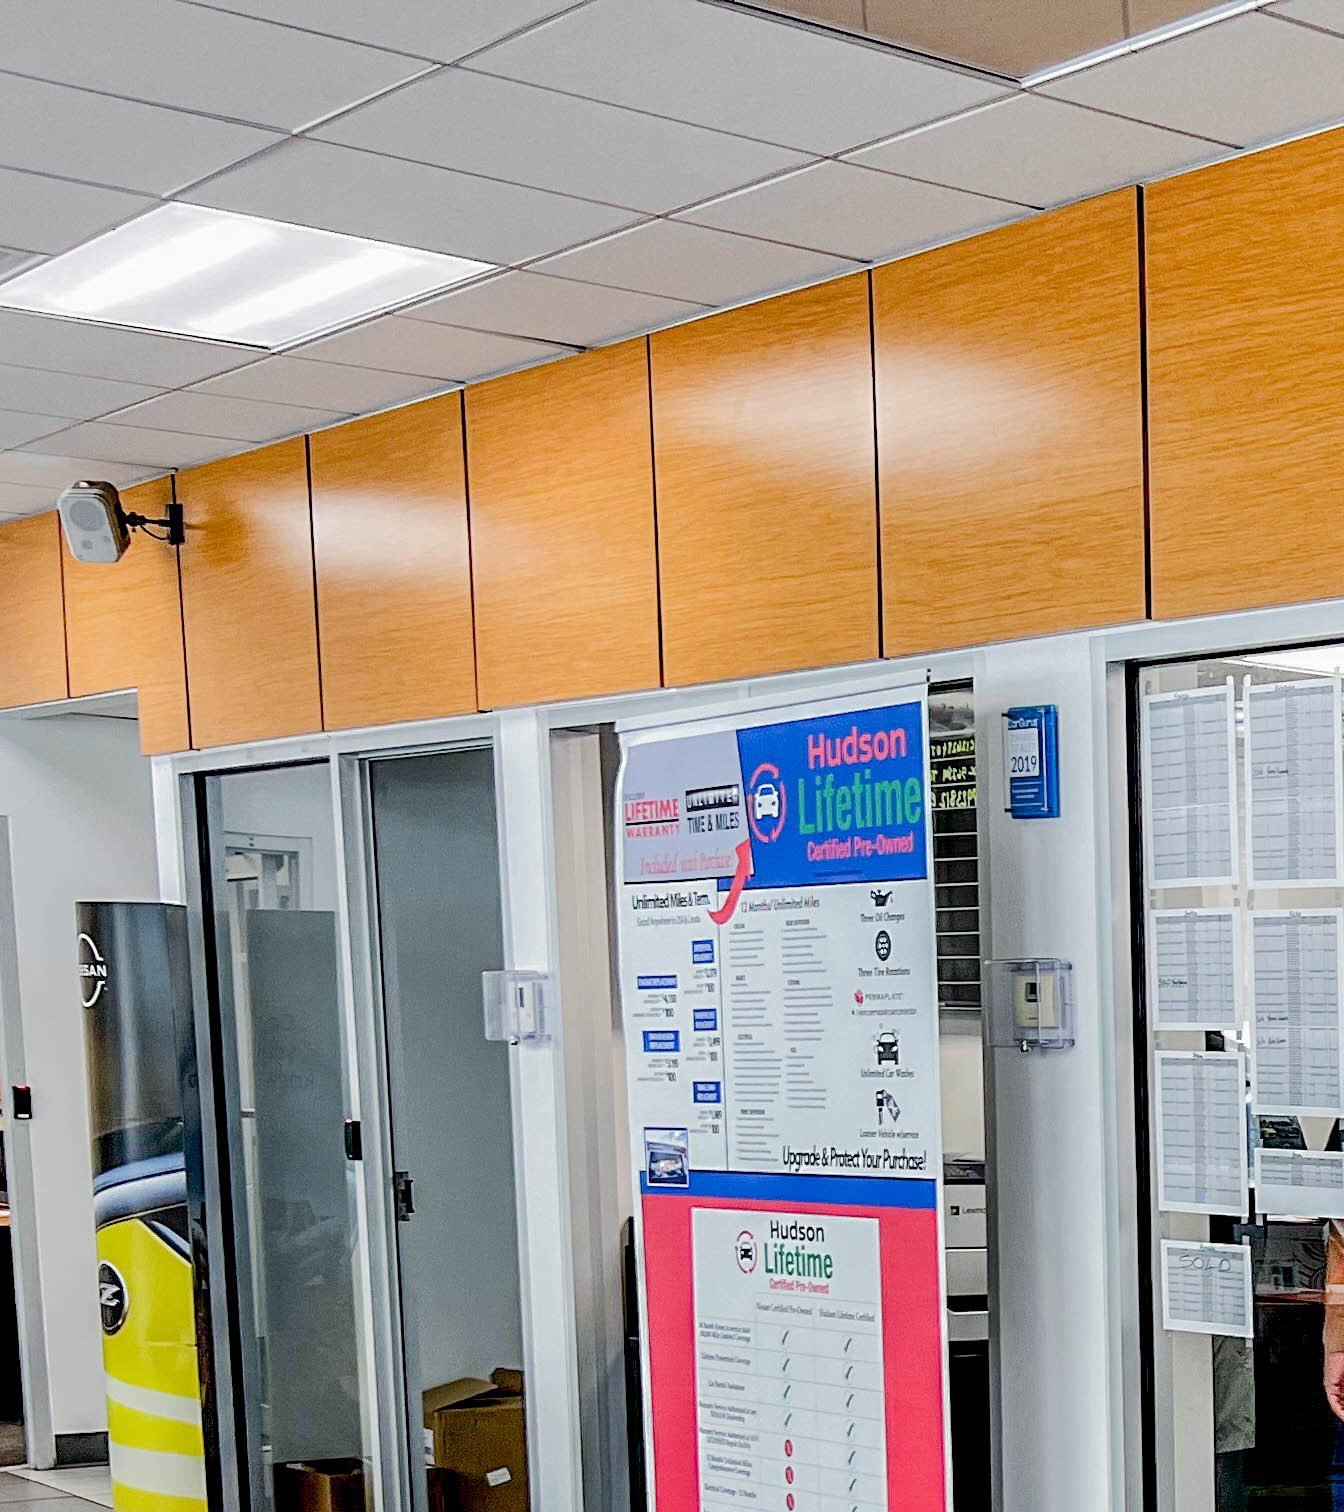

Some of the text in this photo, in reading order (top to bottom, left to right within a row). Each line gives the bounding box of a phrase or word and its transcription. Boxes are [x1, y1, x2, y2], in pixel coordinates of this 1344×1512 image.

[807, 726, 907, 770] Hudson
[1011, 755, 1037, 773] 2019
[625, 798, 679, 822] LIFETIME
[798, 768, 922, 836] Lifetime
[626, 824, 681, 838] WARRANTY
[687, 814, 705, 834] TIME
[715, 811, 740, 831] MILES
[807, 831, 914, 862] Certified Pre-Owned
[632, 893, 669, 910] Unlimited
[670, 892, 687, 908] Miles
[782, 1145, 820, 1172] Upgrade
[821, 1147, 829, 1167] &
[830, 1147, 860, 1168] Protect
[861, 1147, 882, 1169] Your
[769, 1219, 825, 1243] Hudson
[763, 1242, 834, 1279] Lifetime
[1168, 1254, 1232, 1273] SOLD
